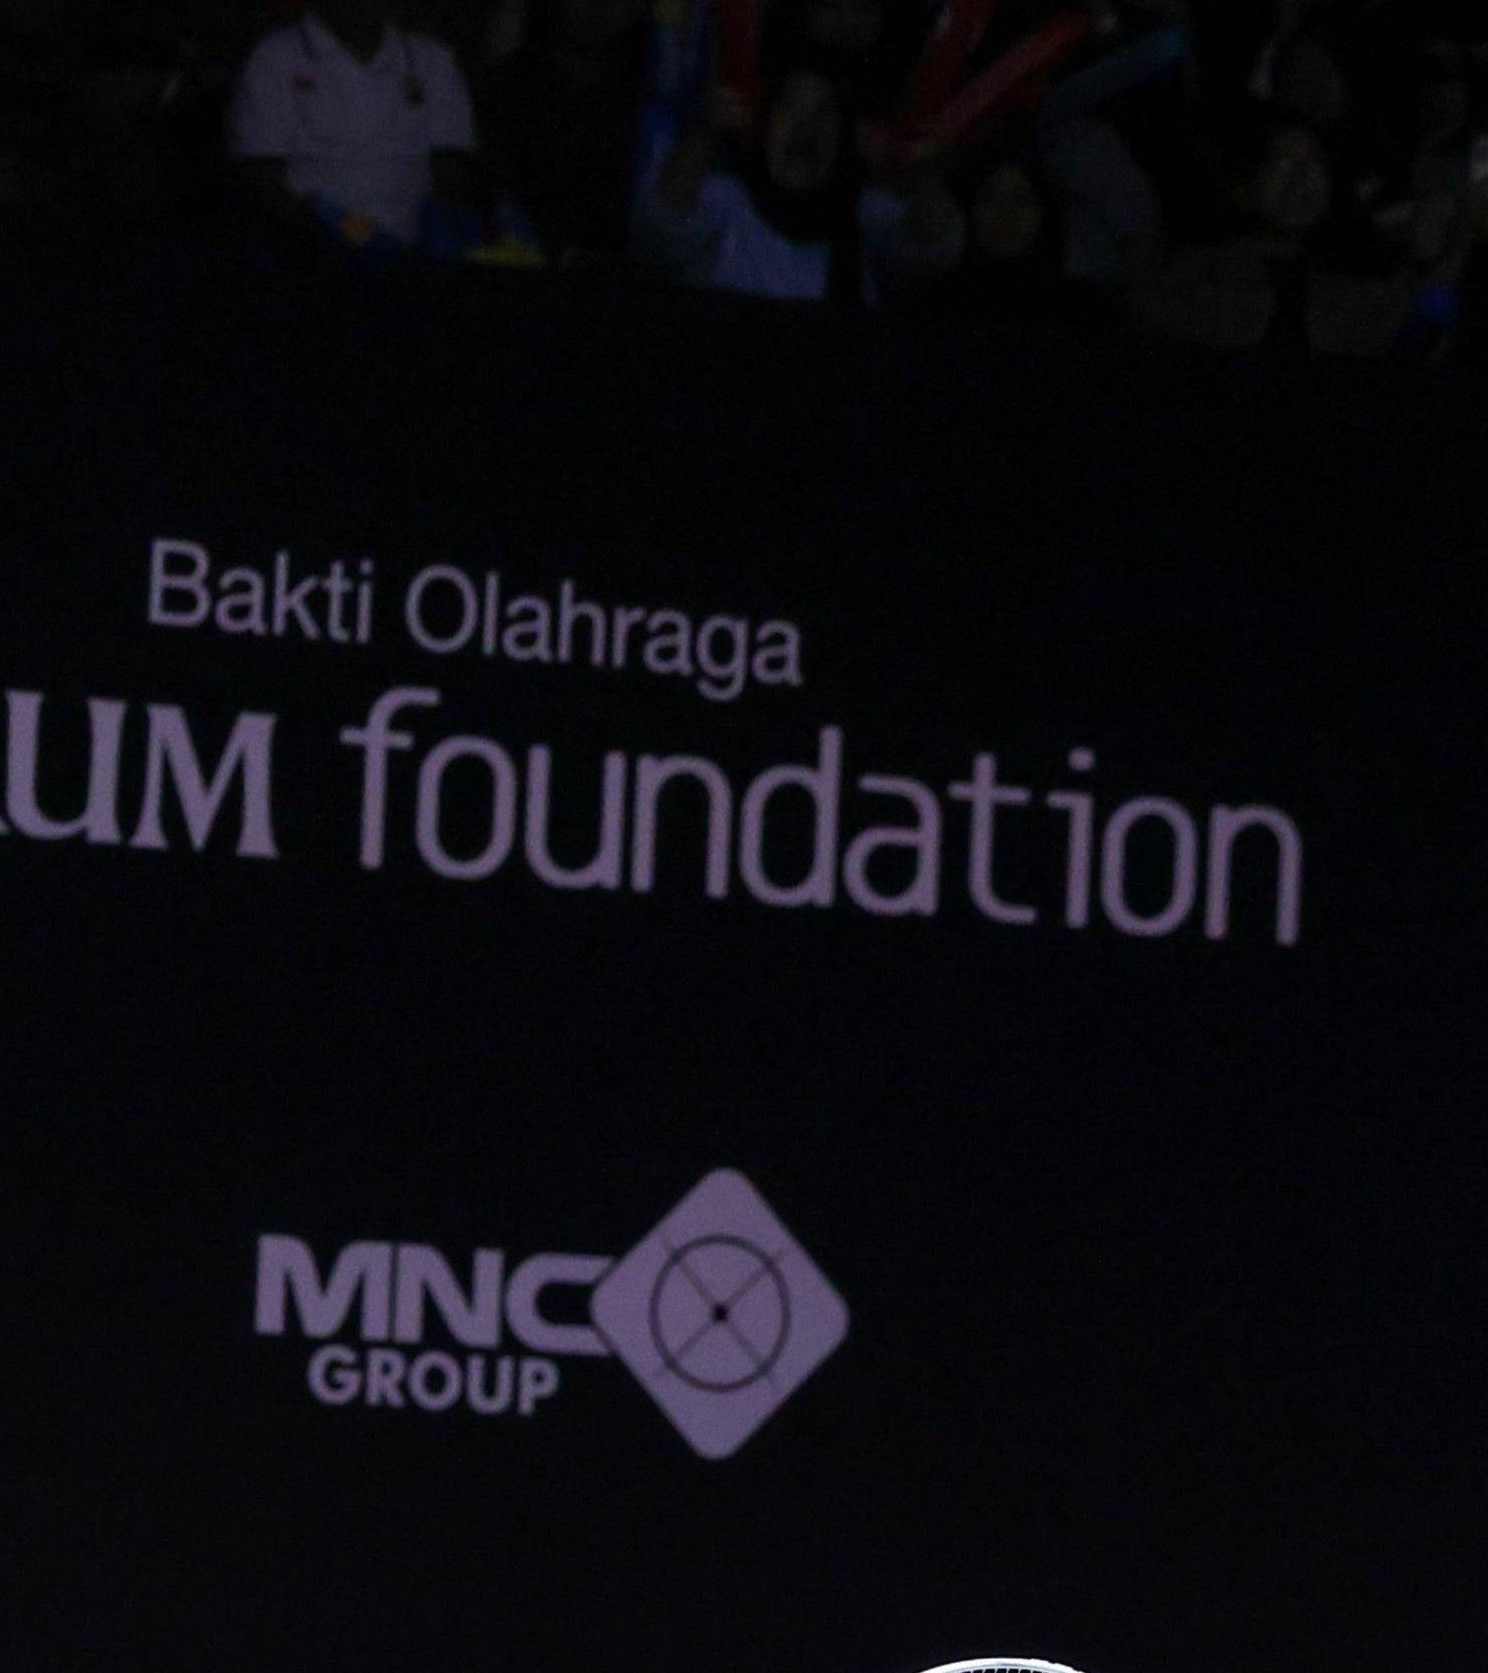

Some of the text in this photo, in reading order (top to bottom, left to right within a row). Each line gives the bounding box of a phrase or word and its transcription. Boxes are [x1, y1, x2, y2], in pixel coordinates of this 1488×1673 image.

[147, 538, 803, 701] Bakti Olahraga
[339, 687, 1303, 946] foundation
[255, 1234, 616, 1358] MNC
[308, 1346, 559, 1416] GROUP
